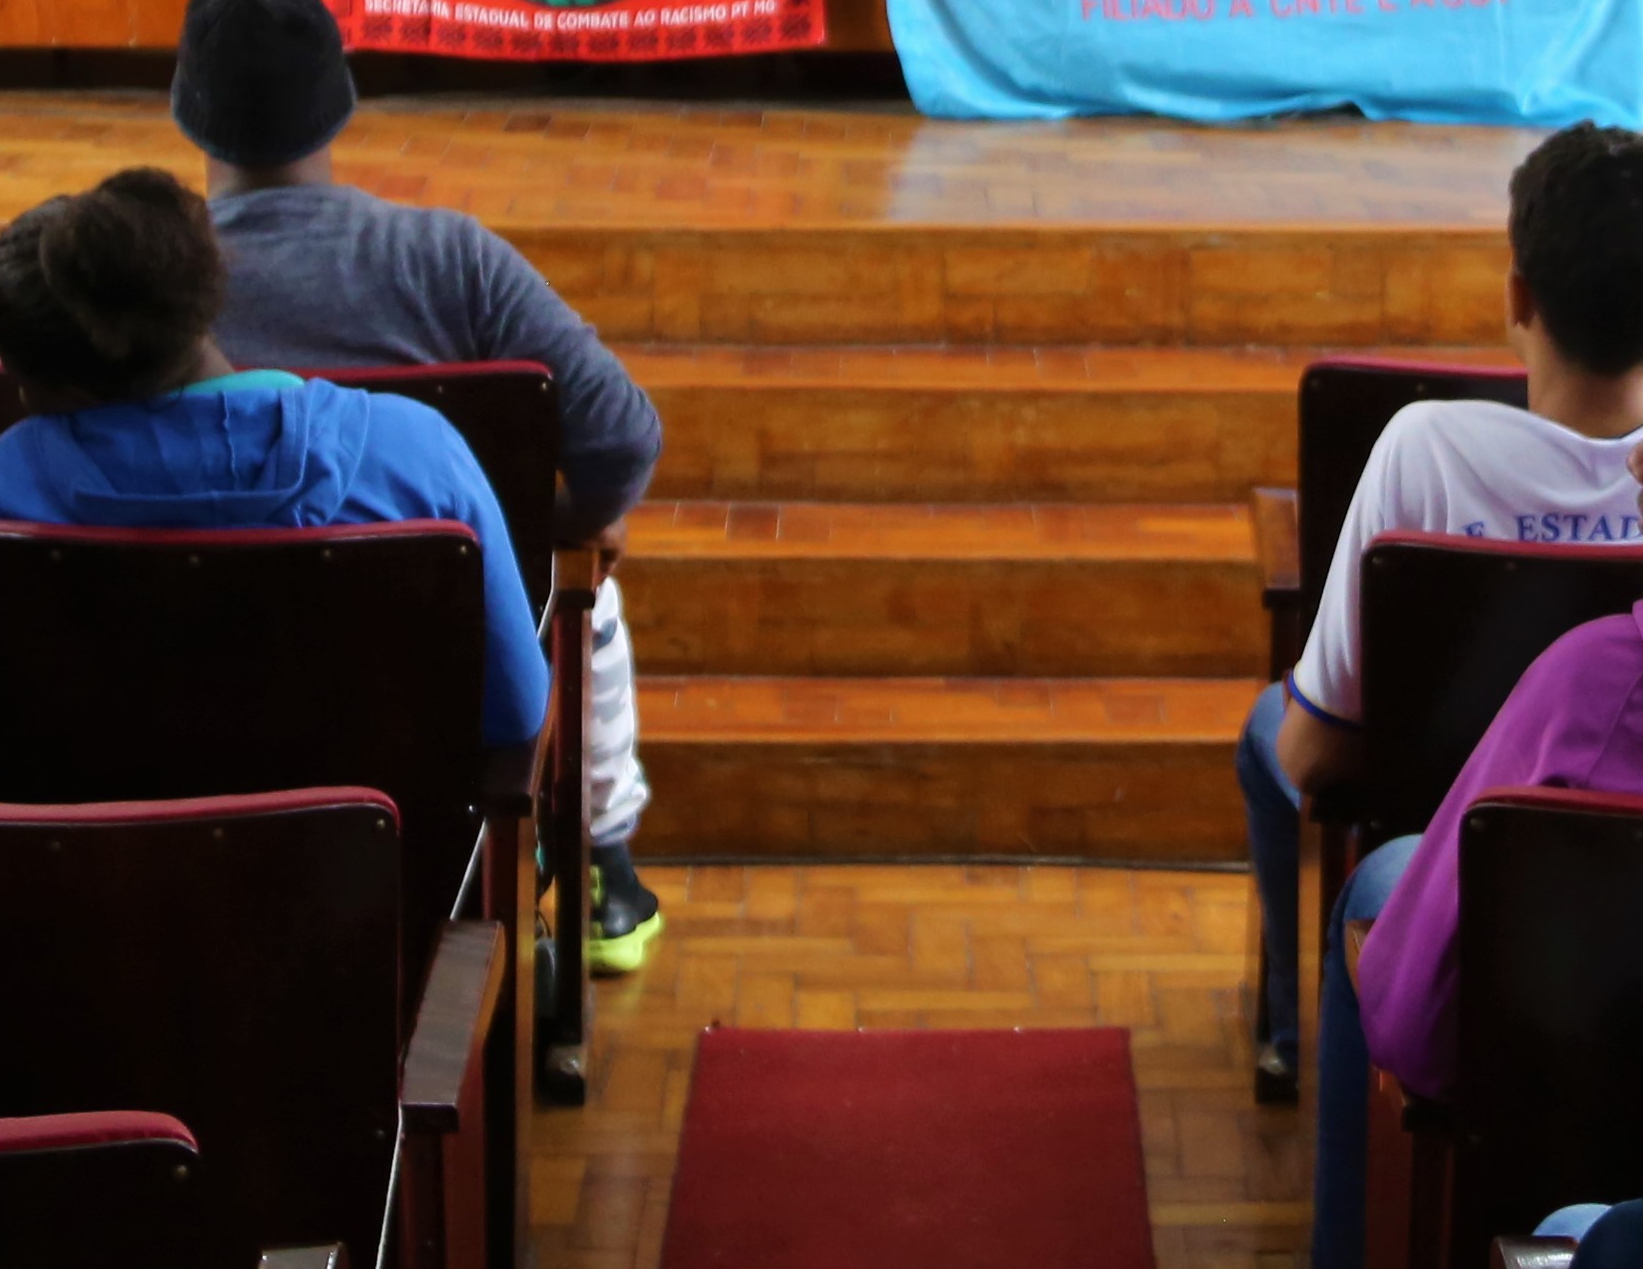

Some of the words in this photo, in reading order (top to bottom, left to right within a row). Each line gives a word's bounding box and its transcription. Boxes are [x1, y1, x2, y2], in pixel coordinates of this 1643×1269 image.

[455, 2, 530, 29] ESTADUAL
[534, 11, 553, 31] DE
[557, 10, 628, 31] COMBATE
[634, 10, 655, 27] AO
[660, 6, 727, 26] RACISMO
